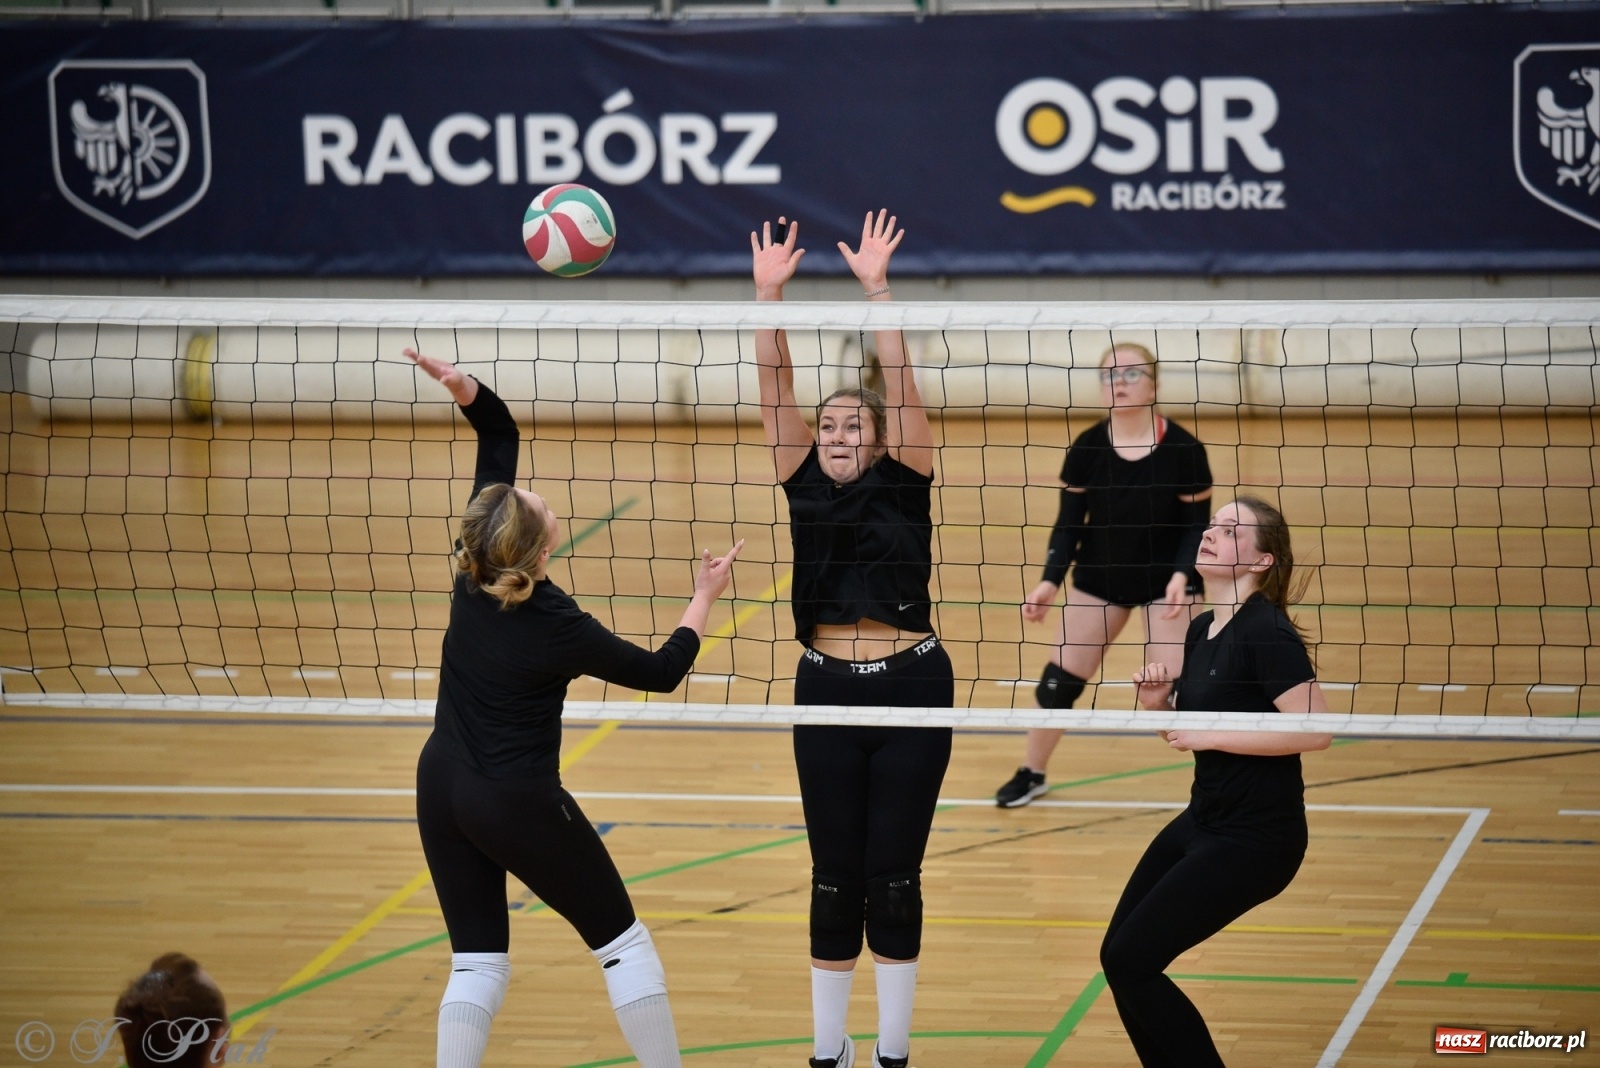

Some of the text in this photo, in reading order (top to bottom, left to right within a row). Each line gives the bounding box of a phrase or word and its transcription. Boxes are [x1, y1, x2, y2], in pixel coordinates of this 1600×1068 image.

[303, 89, 781, 186] RACIBÓRZ
[1111, 174, 1286, 211] RACIBÓRZ
[850, 661, 887, 674] TEAM
